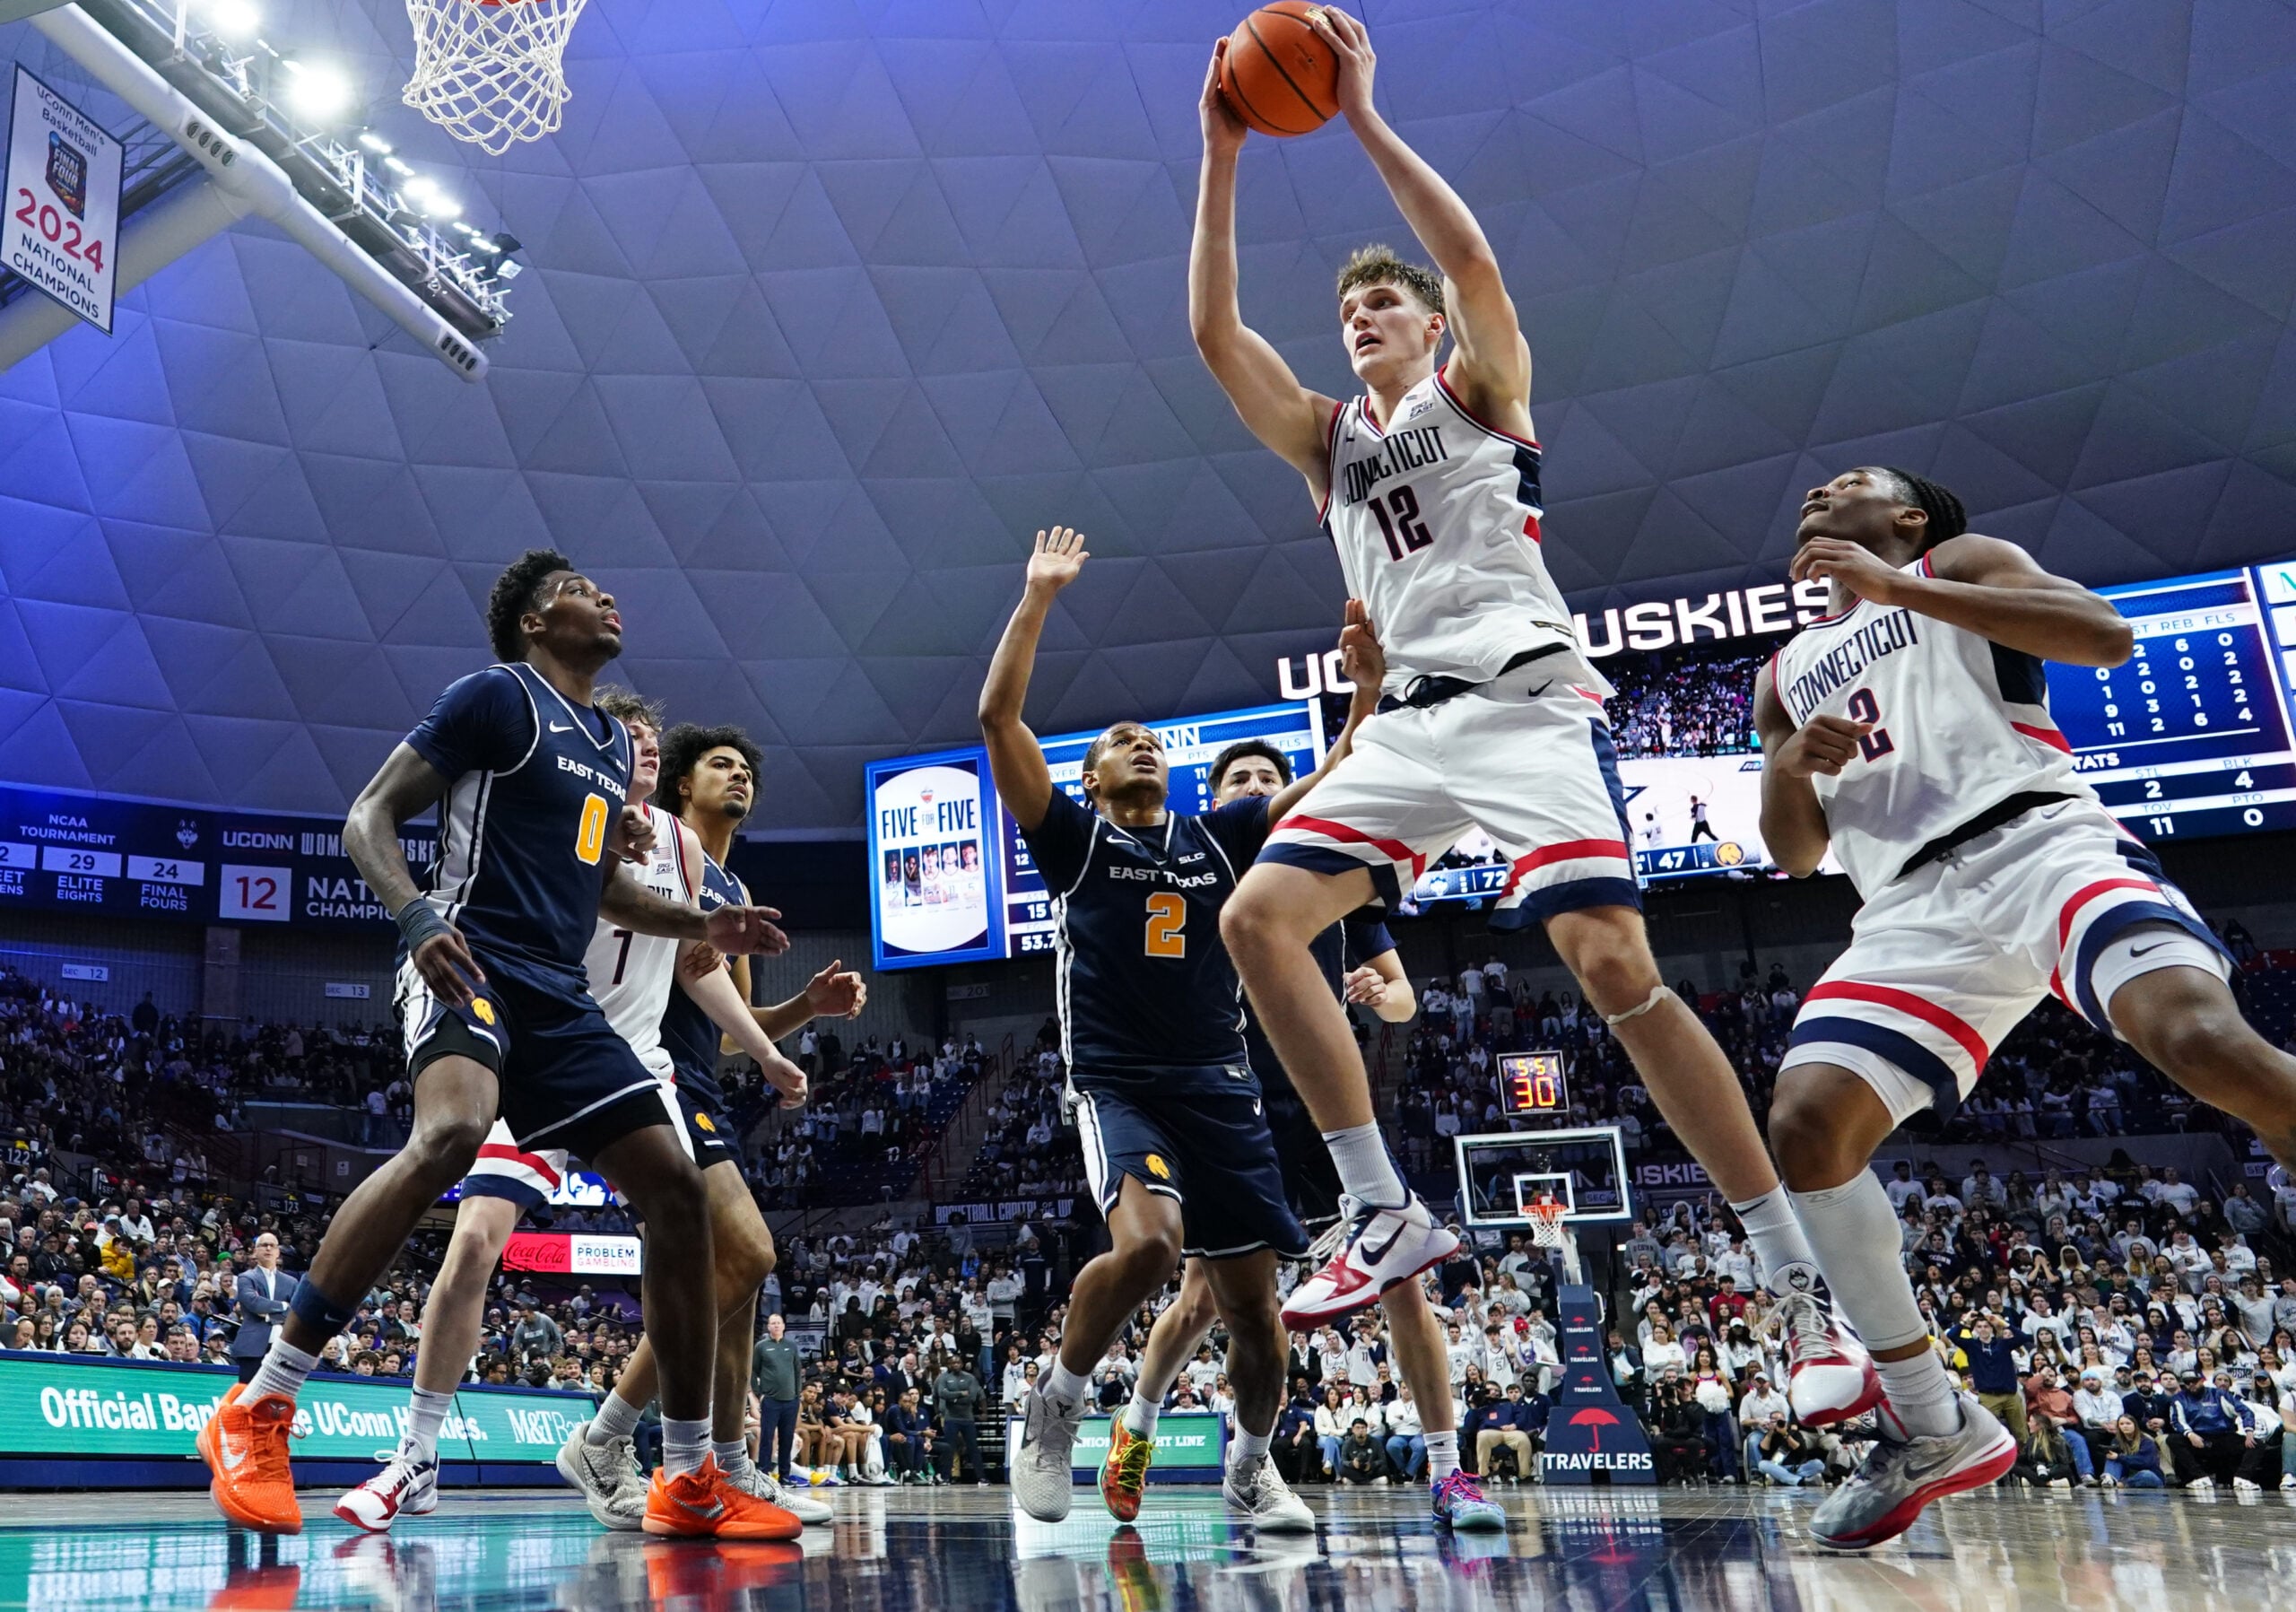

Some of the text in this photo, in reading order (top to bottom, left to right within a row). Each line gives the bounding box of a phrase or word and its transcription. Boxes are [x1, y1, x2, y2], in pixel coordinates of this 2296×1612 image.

[37, 85, 105, 145] UConn Men's
[41, 108, 98, 157] Basketball
[53, 147, 80, 175] FINAL
[51, 162, 79, 187] FOUR
[15, 187, 104, 274] 2024
[22, 233, 95, 294] NATIONAL
[13, 252, 100, 318] CHAMPIONS
[1368, 484, 1434, 562] 12
[2161, 618, 2194, 632] REB
[2205, 613, 2236, 624] FLS
[2133, 632, 2233, 658] 2 6 0
[1787, 607, 1918, 725] CONNECTICUT
[2095, 651, 2238, 681] 0 2 0 2
[2101, 670, 2243, 699] 1 0 2 2
[2104, 689, 2248, 719] 9 3 1 2
[1848, 687, 1895, 763] 2
[2107, 707, 2253, 736] 11 2 6 4
[1188, 737, 1301, 761] PTS FLS
[557, 755, 595, 782] EAST
[596, 771, 627, 802] TEXAS
[1194, 767, 1207, 780] 11
[2135, 757, 2253, 780] STL BLK
[1197, 783, 1207, 796] 8
[2144, 771, 2254, 799] 2 4
[1199, 799, 1209, 812] 2
[2142, 792, 2264, 815] TOV PTO
[48, 814, 88, 829] NCAA
[575, 792, 609, 866] 0
[883, 798, 977, 840] FIVE FOR FIVE
[2149, 808, 2264, 835] 11 0
[20, 825, 117, 845] TOURNAMENT
[223, 831, 294, 850] UCONN
[68, 853, 96, 870] 29
[152, 862, 179, 879] 24
[1014, 853, 1030, 867] 12
[1483, 870, 1508, 889] 72
[1657, 850, 1686, 869] 47
[57, 875, 104, 892] ELITE
[1109, 866, 1160, 882] EAST
[57, 889, 103, 903] EIGHTS
[141, 884, 188, 900] FINAL
[236, 876, 277, 911] 12
[308, 876, 379, 902] NAT
[140, 896, 188, 911] FOURS
[1027, 903, 1047, 919] 15
[1144, 891, 1187, 959] 2
[612, 929, 634, 985] 7
[89, 968, 104, 980] 12
[352, 986, 365, 998] 13
[1517, 1058, 1558, 1076] 5:51
[1513, 1076, 1556, 1109] 30
[7, 1147, 30, 1165] 122
[577, 1247, 635, 1259] PROBLEM
[577, 1258, 636, 1268] GAMBLING
[1566, 1326, 1594, 1334] TRAVELERS
[1570, 1355, 1598, 1364] TRAVELERS
[39, 1385, 158, 1430] Official
[312, 1400, 395, 1438] UConn
[392, 1406, 488, 1441] Hkies.
[505, 1408, 556, 1445] M&T
[1175, 1435, 1206, 1447] LINE
[1543, 1452, 1653, 1471] TRAVELERS
